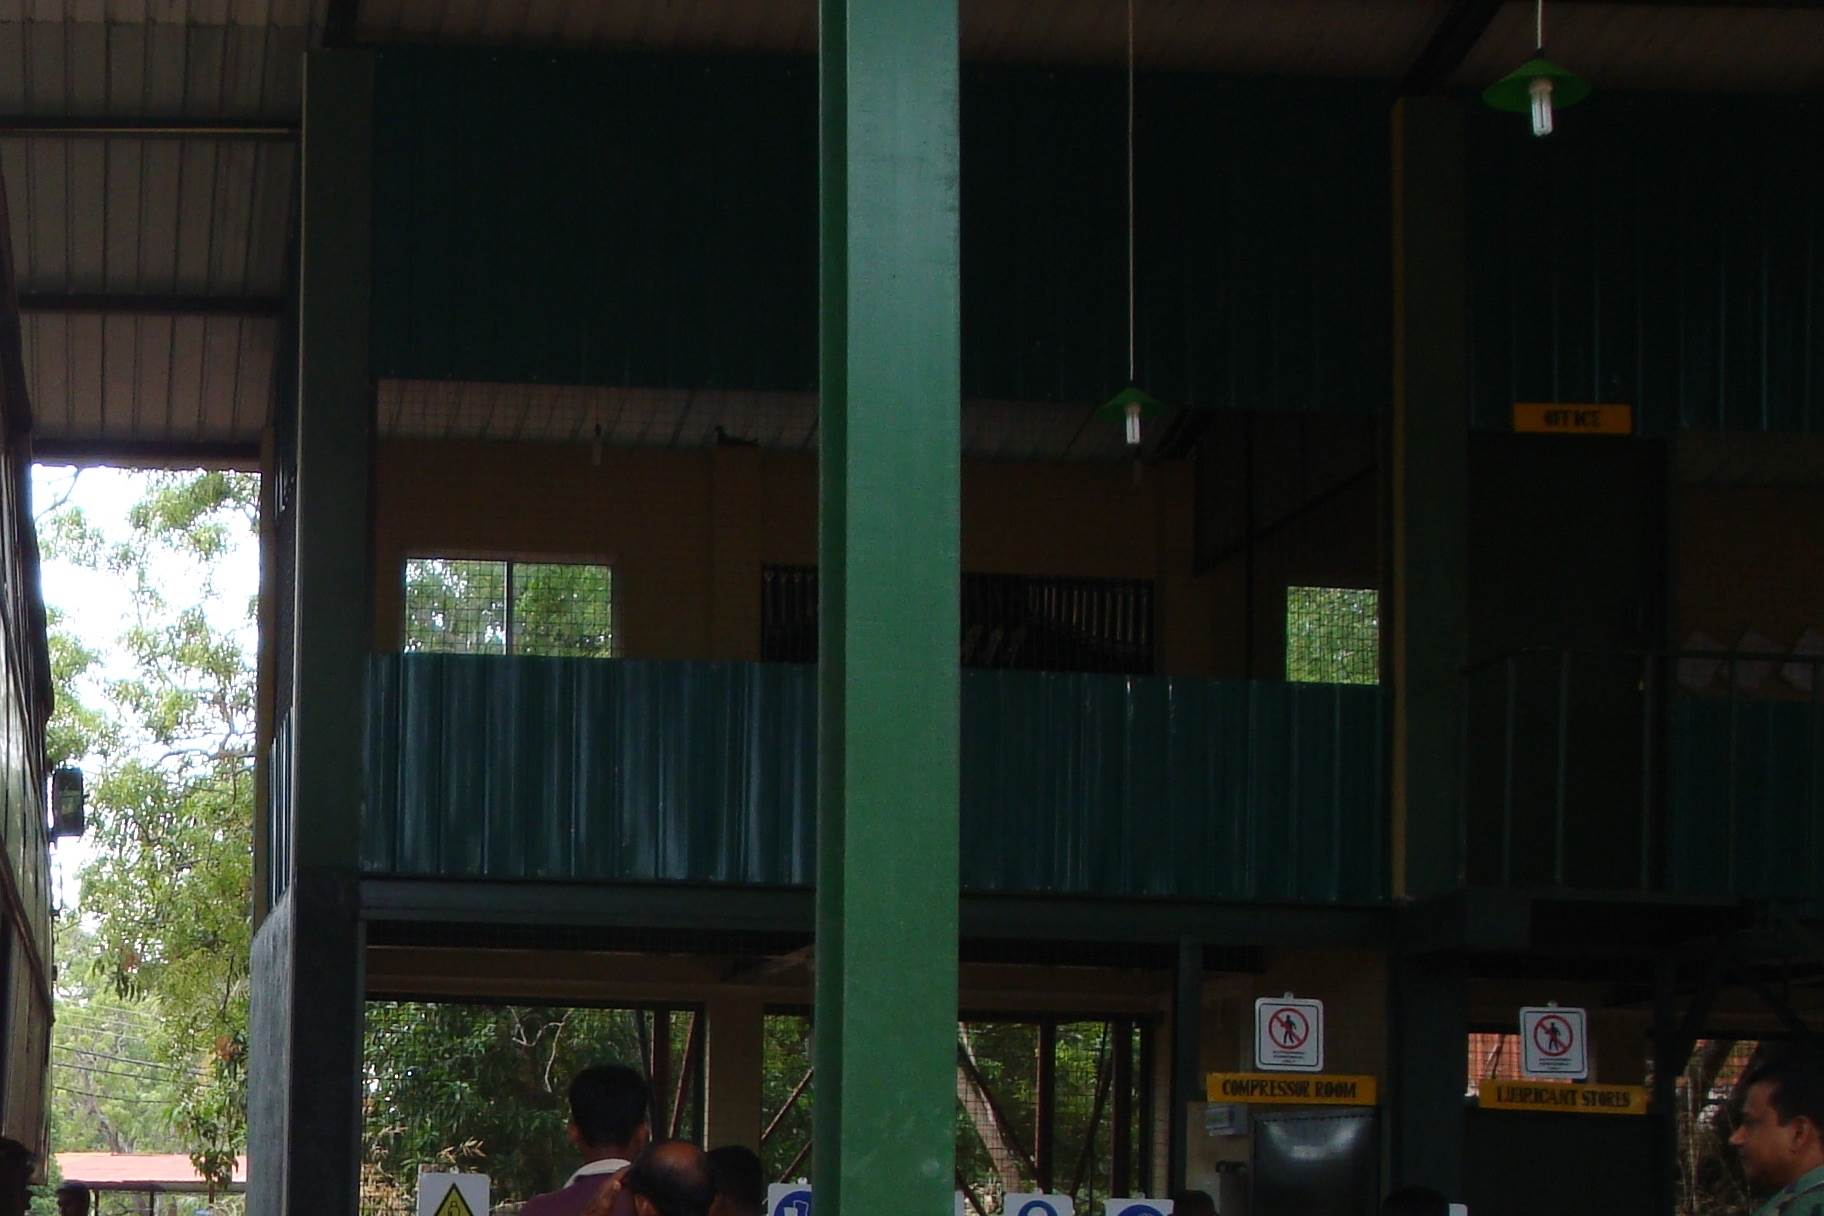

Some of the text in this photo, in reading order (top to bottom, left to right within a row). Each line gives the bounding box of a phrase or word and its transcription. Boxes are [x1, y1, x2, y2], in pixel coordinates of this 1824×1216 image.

[1222, 1078, 1357, 1099] COMPRESSOR ROOM
[1496, 1085, 1631, 1108] LUBRICANT STORES
